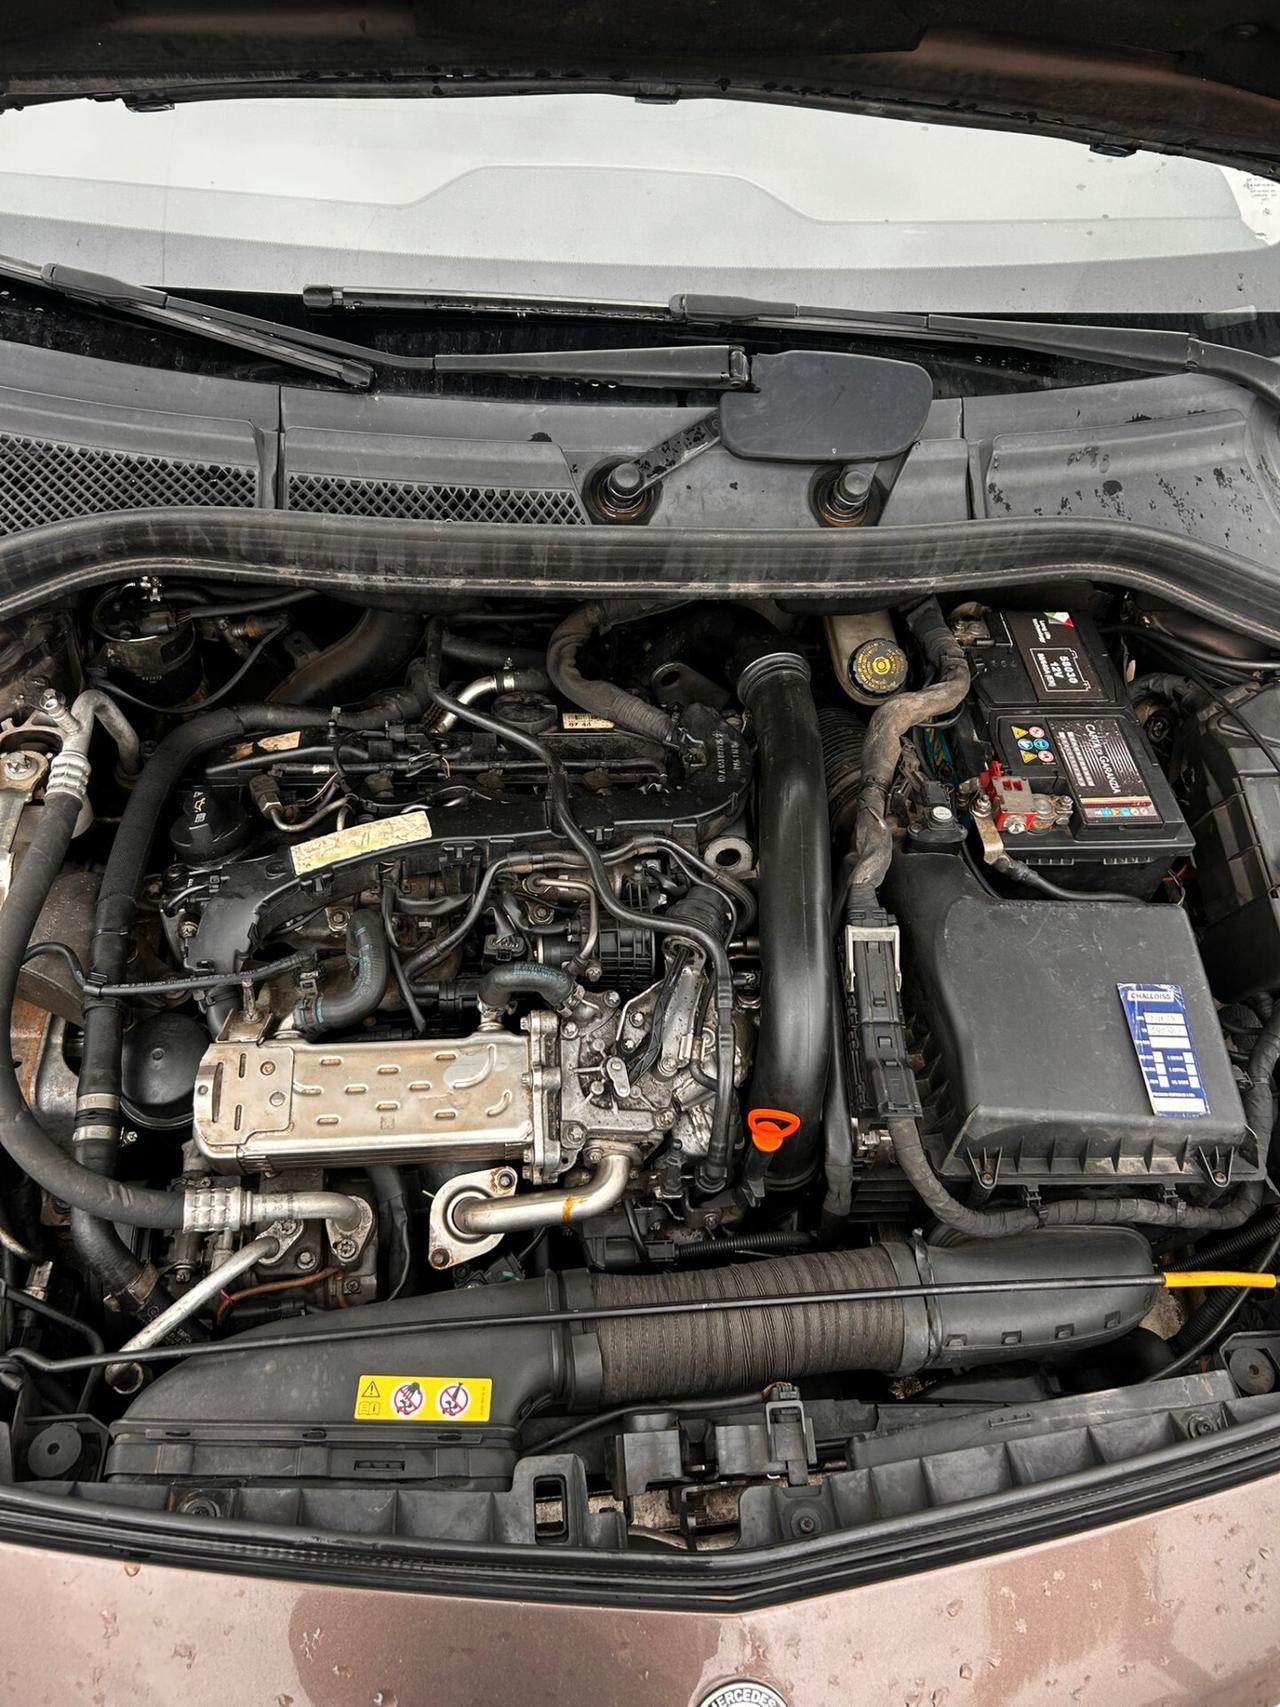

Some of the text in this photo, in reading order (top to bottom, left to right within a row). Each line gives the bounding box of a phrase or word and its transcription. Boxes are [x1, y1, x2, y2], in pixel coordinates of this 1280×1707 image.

[1049, 661, 1065, 679] 12V
[1059, 655, 1079, 684] 58030
[1085, 723, 1103, 748] CARTA
[1099, 755, 1121, 794] GARANZIA
